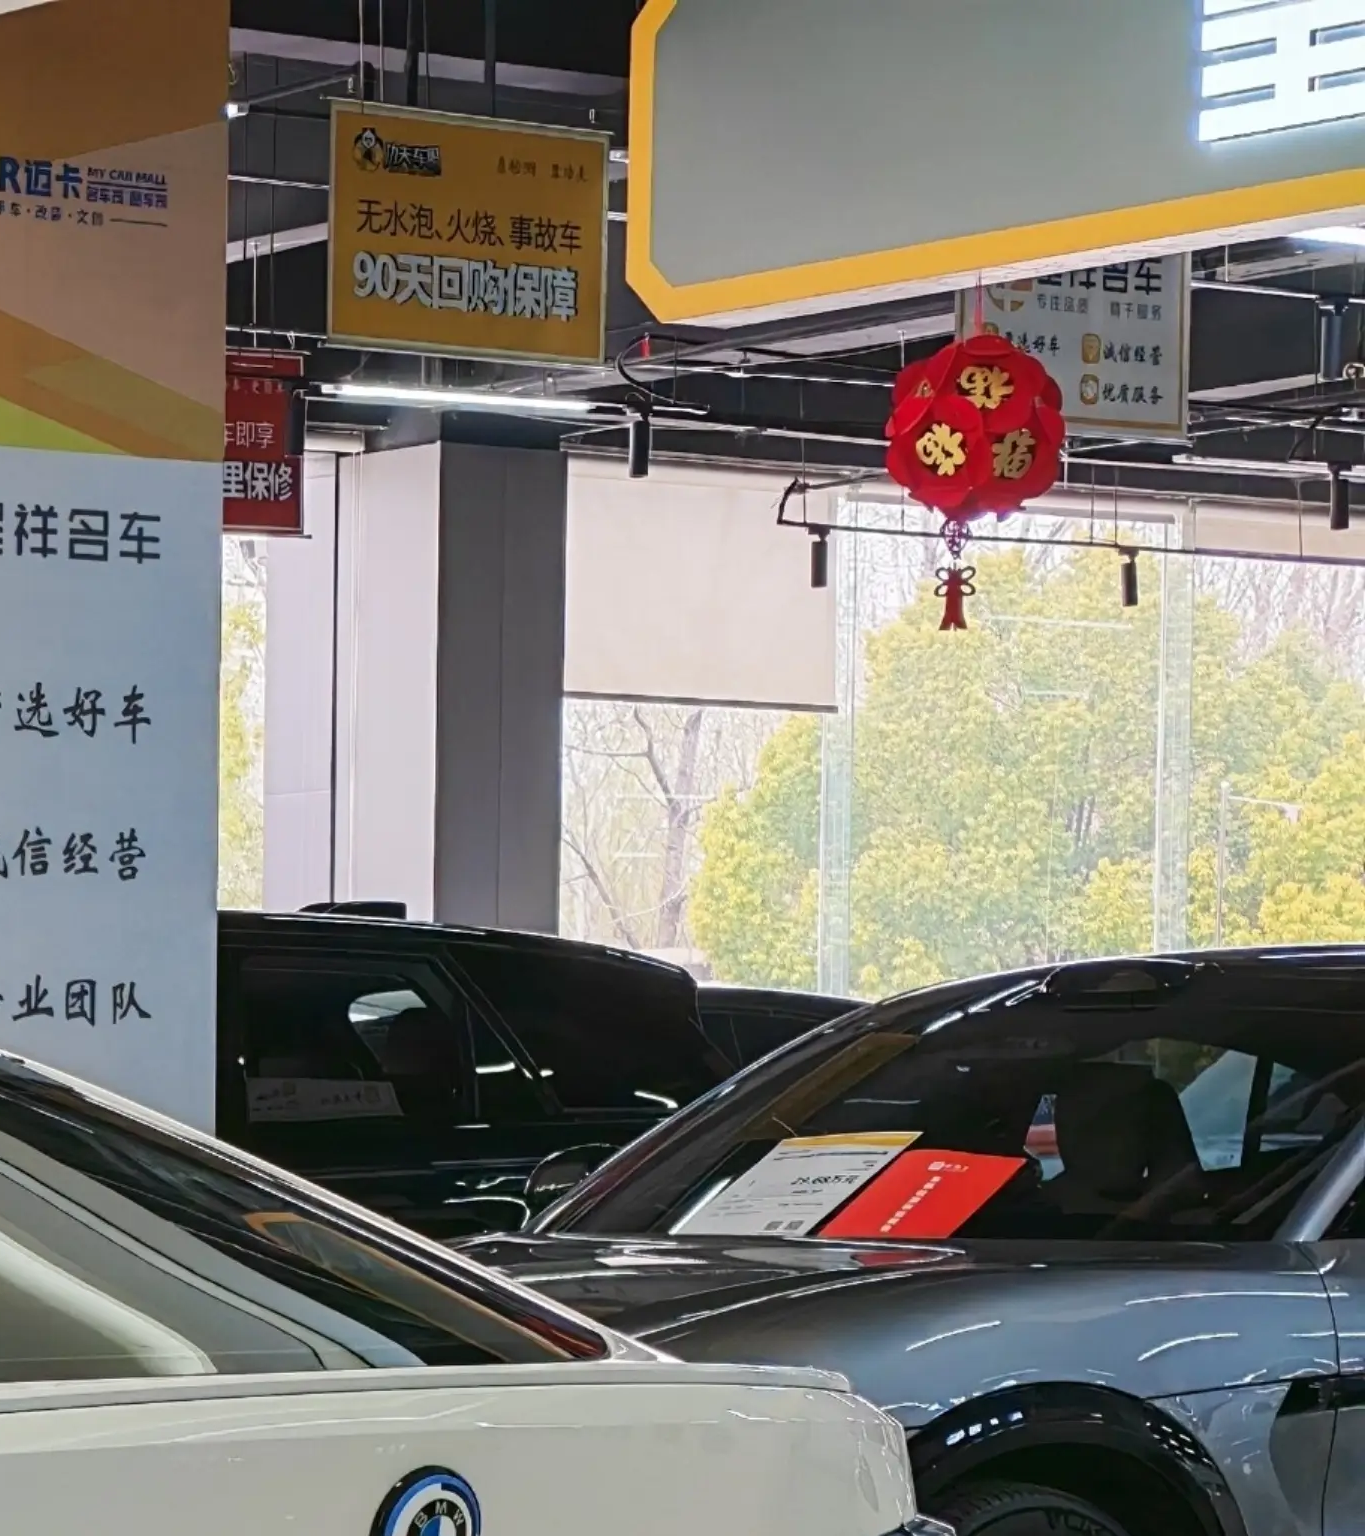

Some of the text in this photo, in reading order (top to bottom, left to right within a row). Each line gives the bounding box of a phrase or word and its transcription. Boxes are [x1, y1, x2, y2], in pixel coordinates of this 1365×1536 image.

[356, 199, 582, 255] 无水泡、火烧、事故车
[353, 250, 579, 323] 90天回购保障
[1102, 342, 1163, 366] 诚信经营
[222, 461, 293, 502] 里保修
[413, 1501, 465, 1529] BMW
